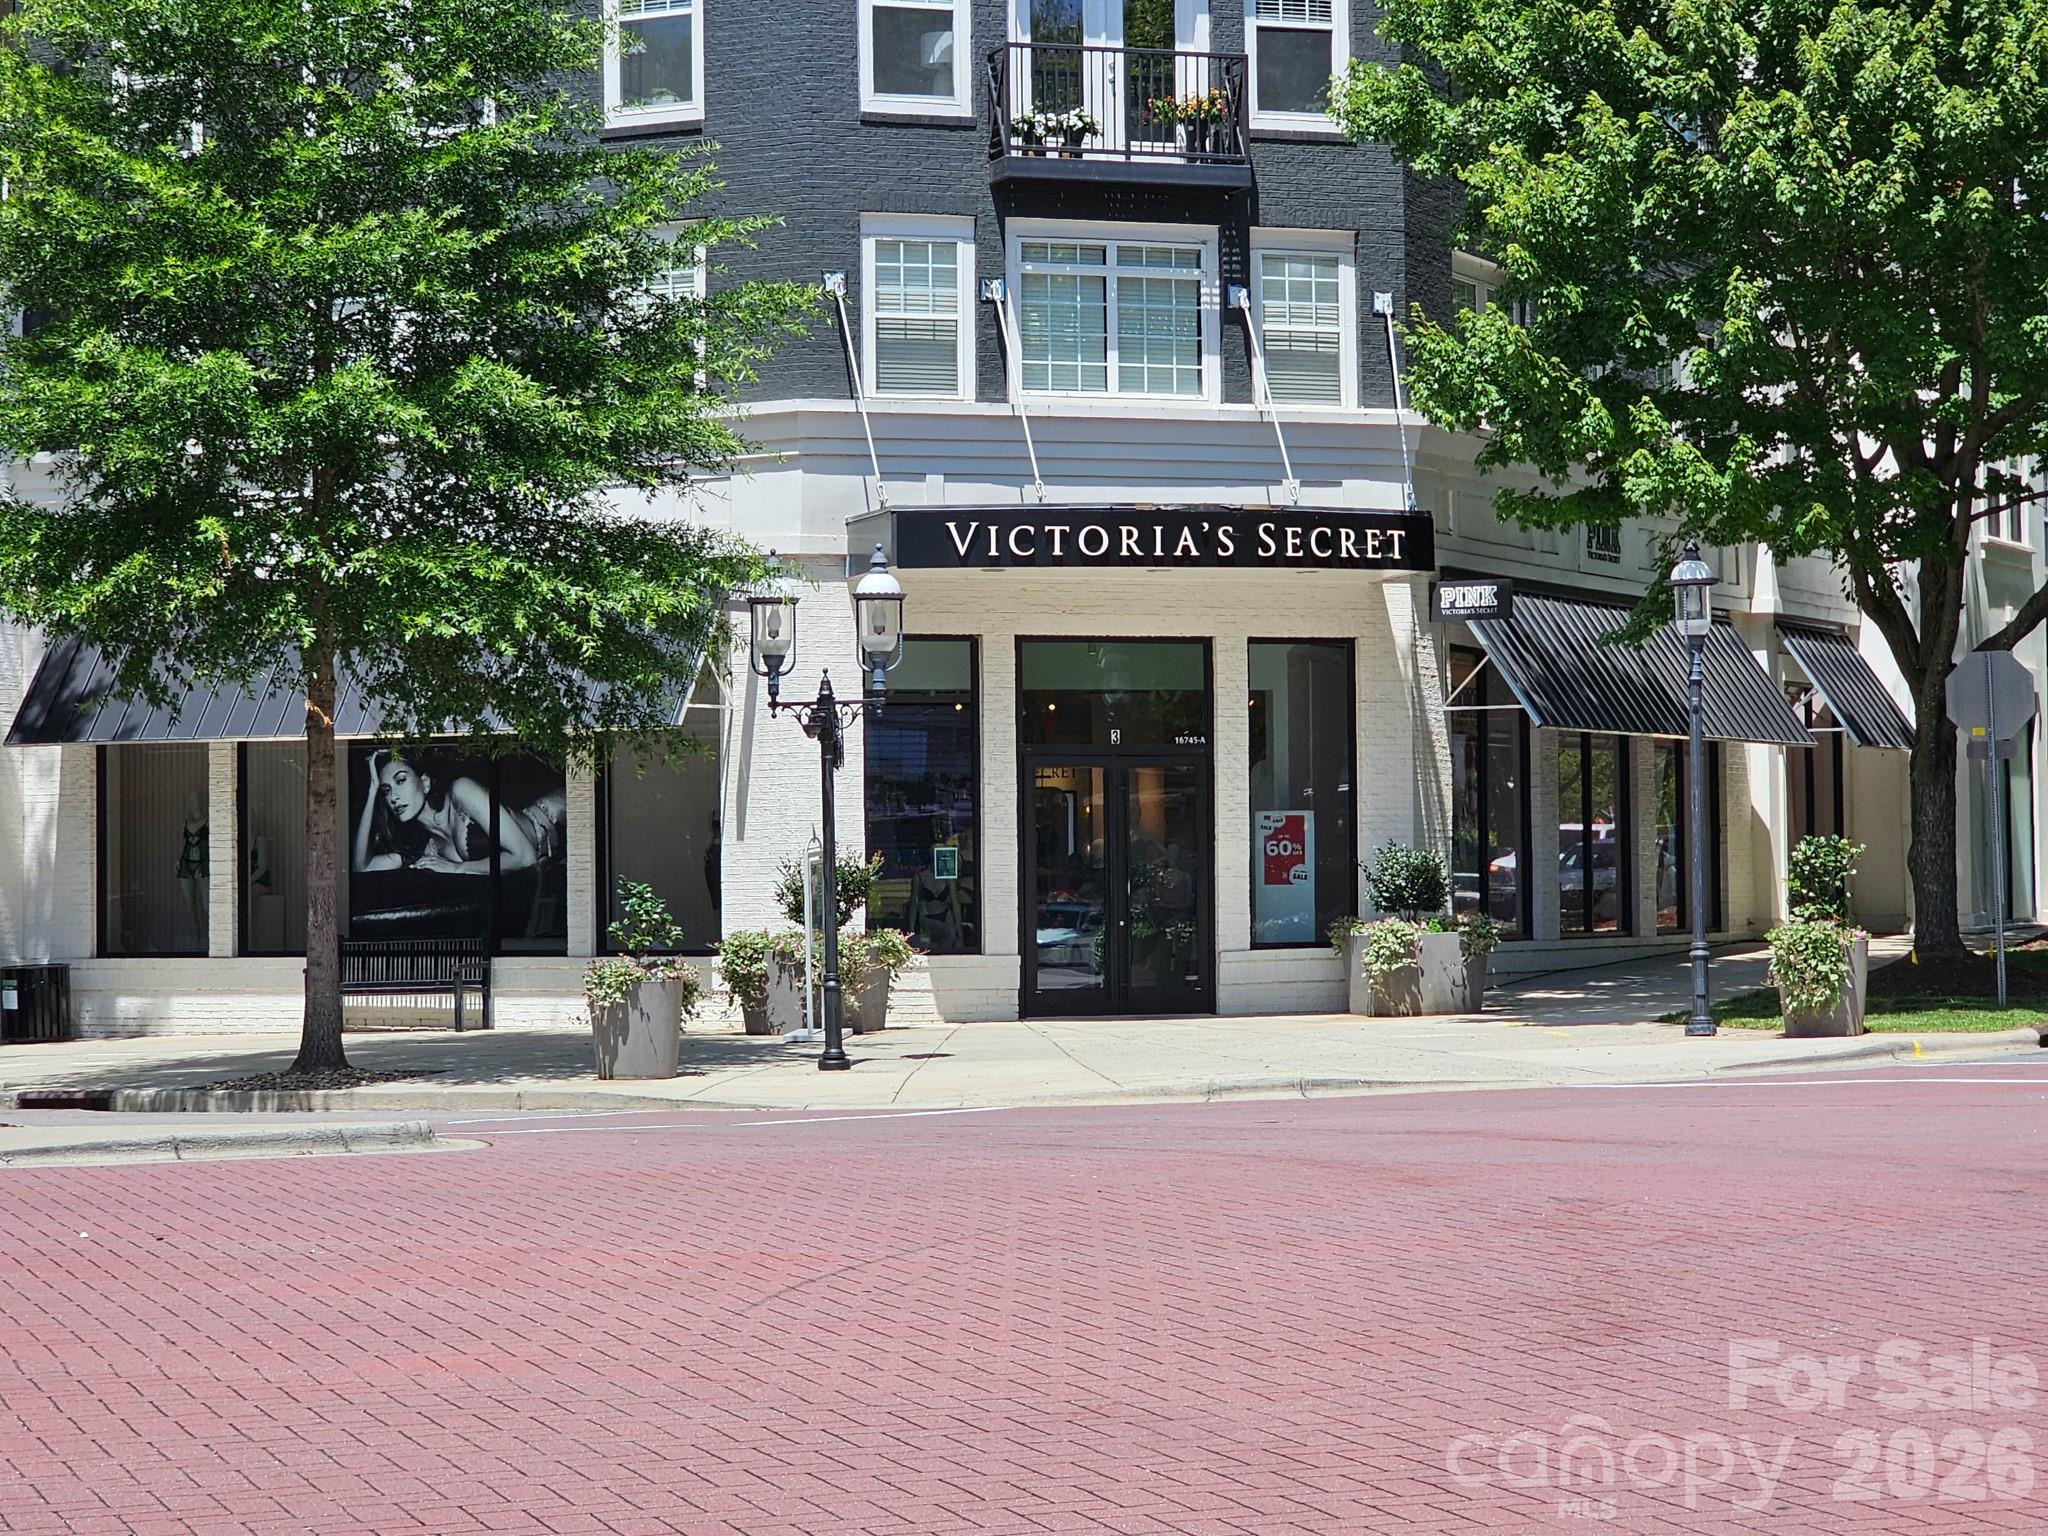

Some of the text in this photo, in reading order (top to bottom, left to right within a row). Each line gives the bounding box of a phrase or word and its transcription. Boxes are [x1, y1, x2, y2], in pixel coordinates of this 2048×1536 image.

[945, 521, 1405, 559] VICTORIA'S SECRET
[1440, 585, 1498, 608] PINK
[1111, 729, 1120, 744] 3
[1174, 736, 1206, 744] 16745-A
